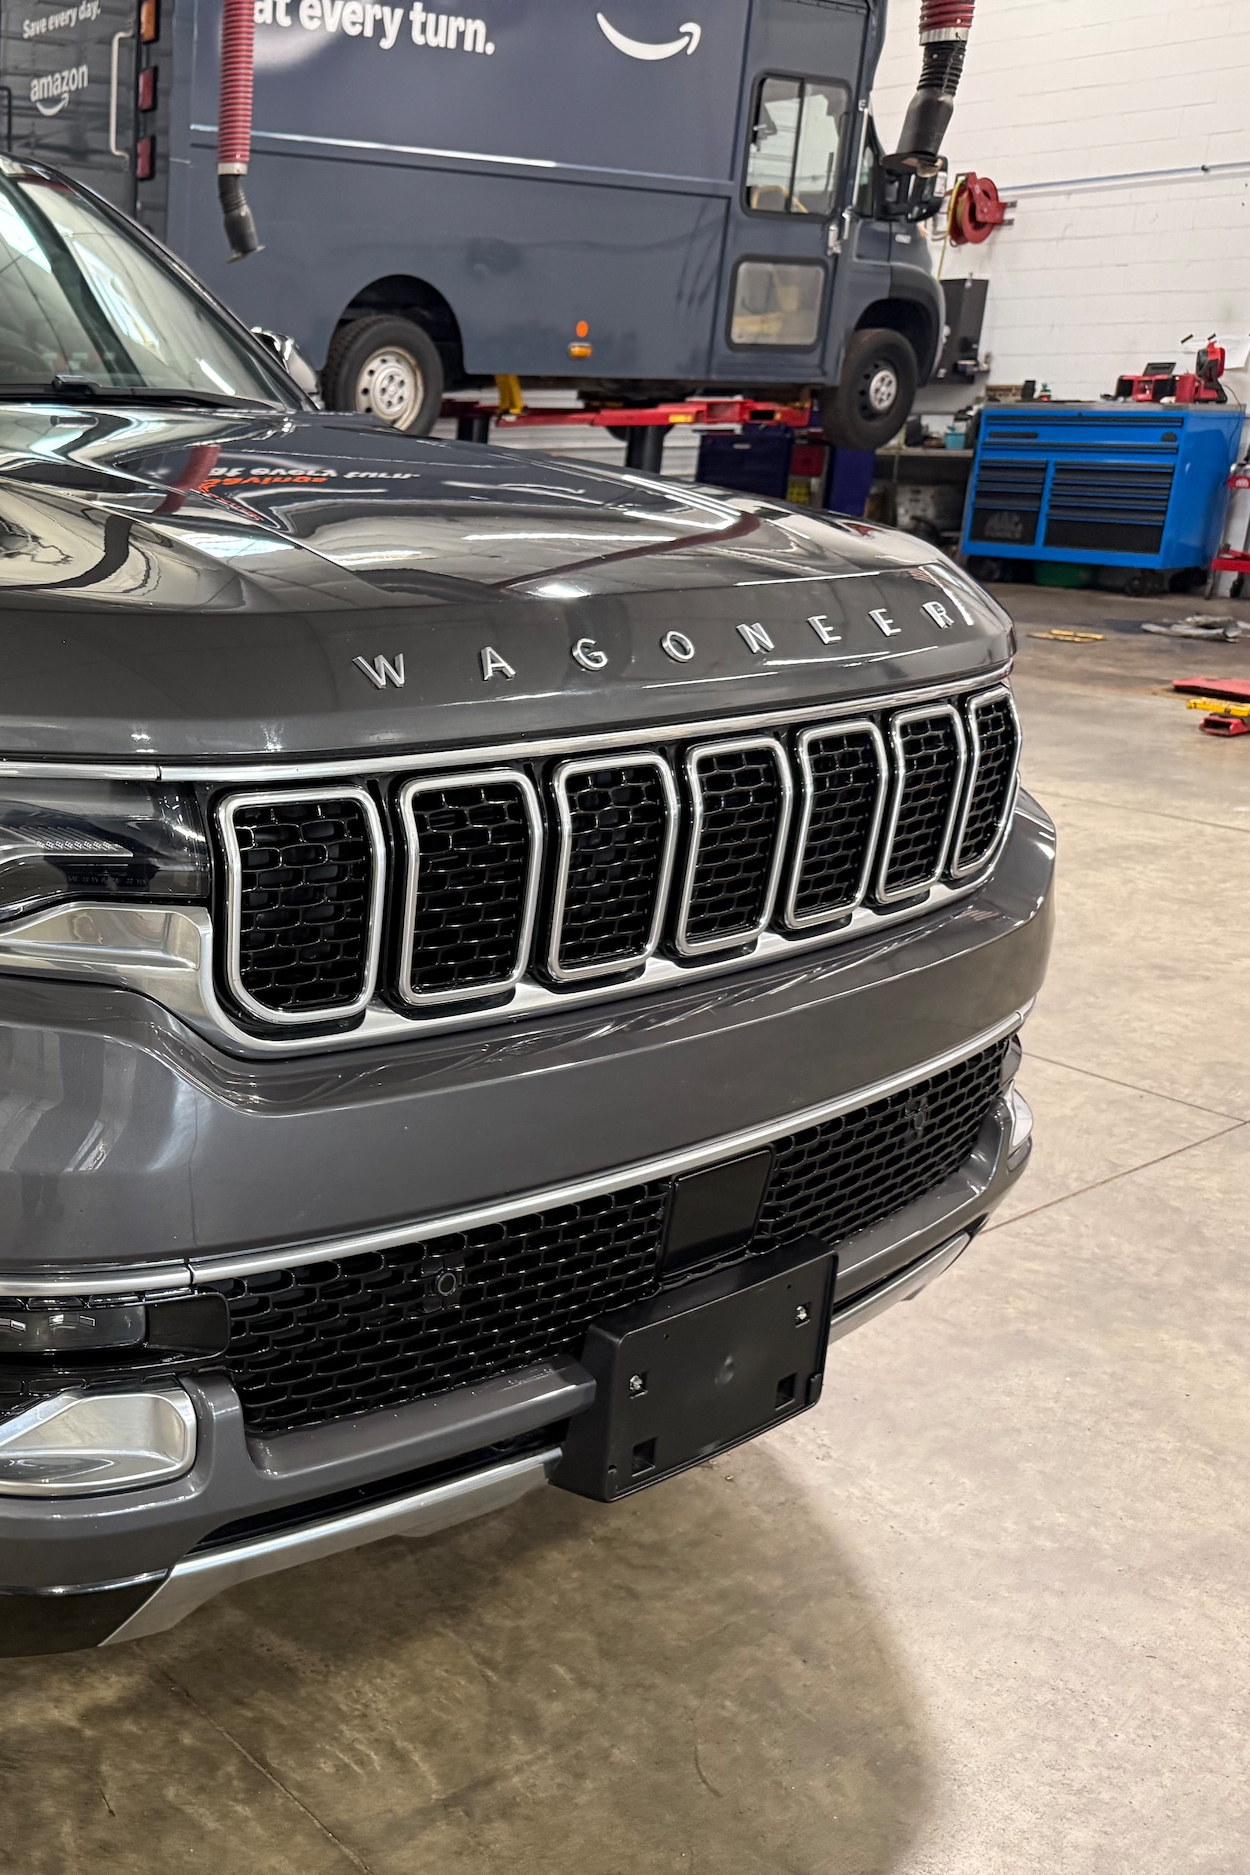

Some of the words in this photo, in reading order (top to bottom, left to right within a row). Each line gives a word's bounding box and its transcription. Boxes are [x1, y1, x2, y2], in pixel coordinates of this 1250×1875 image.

[22, 17, 47, 39] Save
[47, 7, 78, 31] every
[78, 0, 101, 21] day.
[253, 0, 292, 27] at
[299, 0, 404, 50] every
[409, 2, 496, 55] turn.
[30, 64, 89, 102] amazon
[353, 600, 953, 690] WAGONEER
